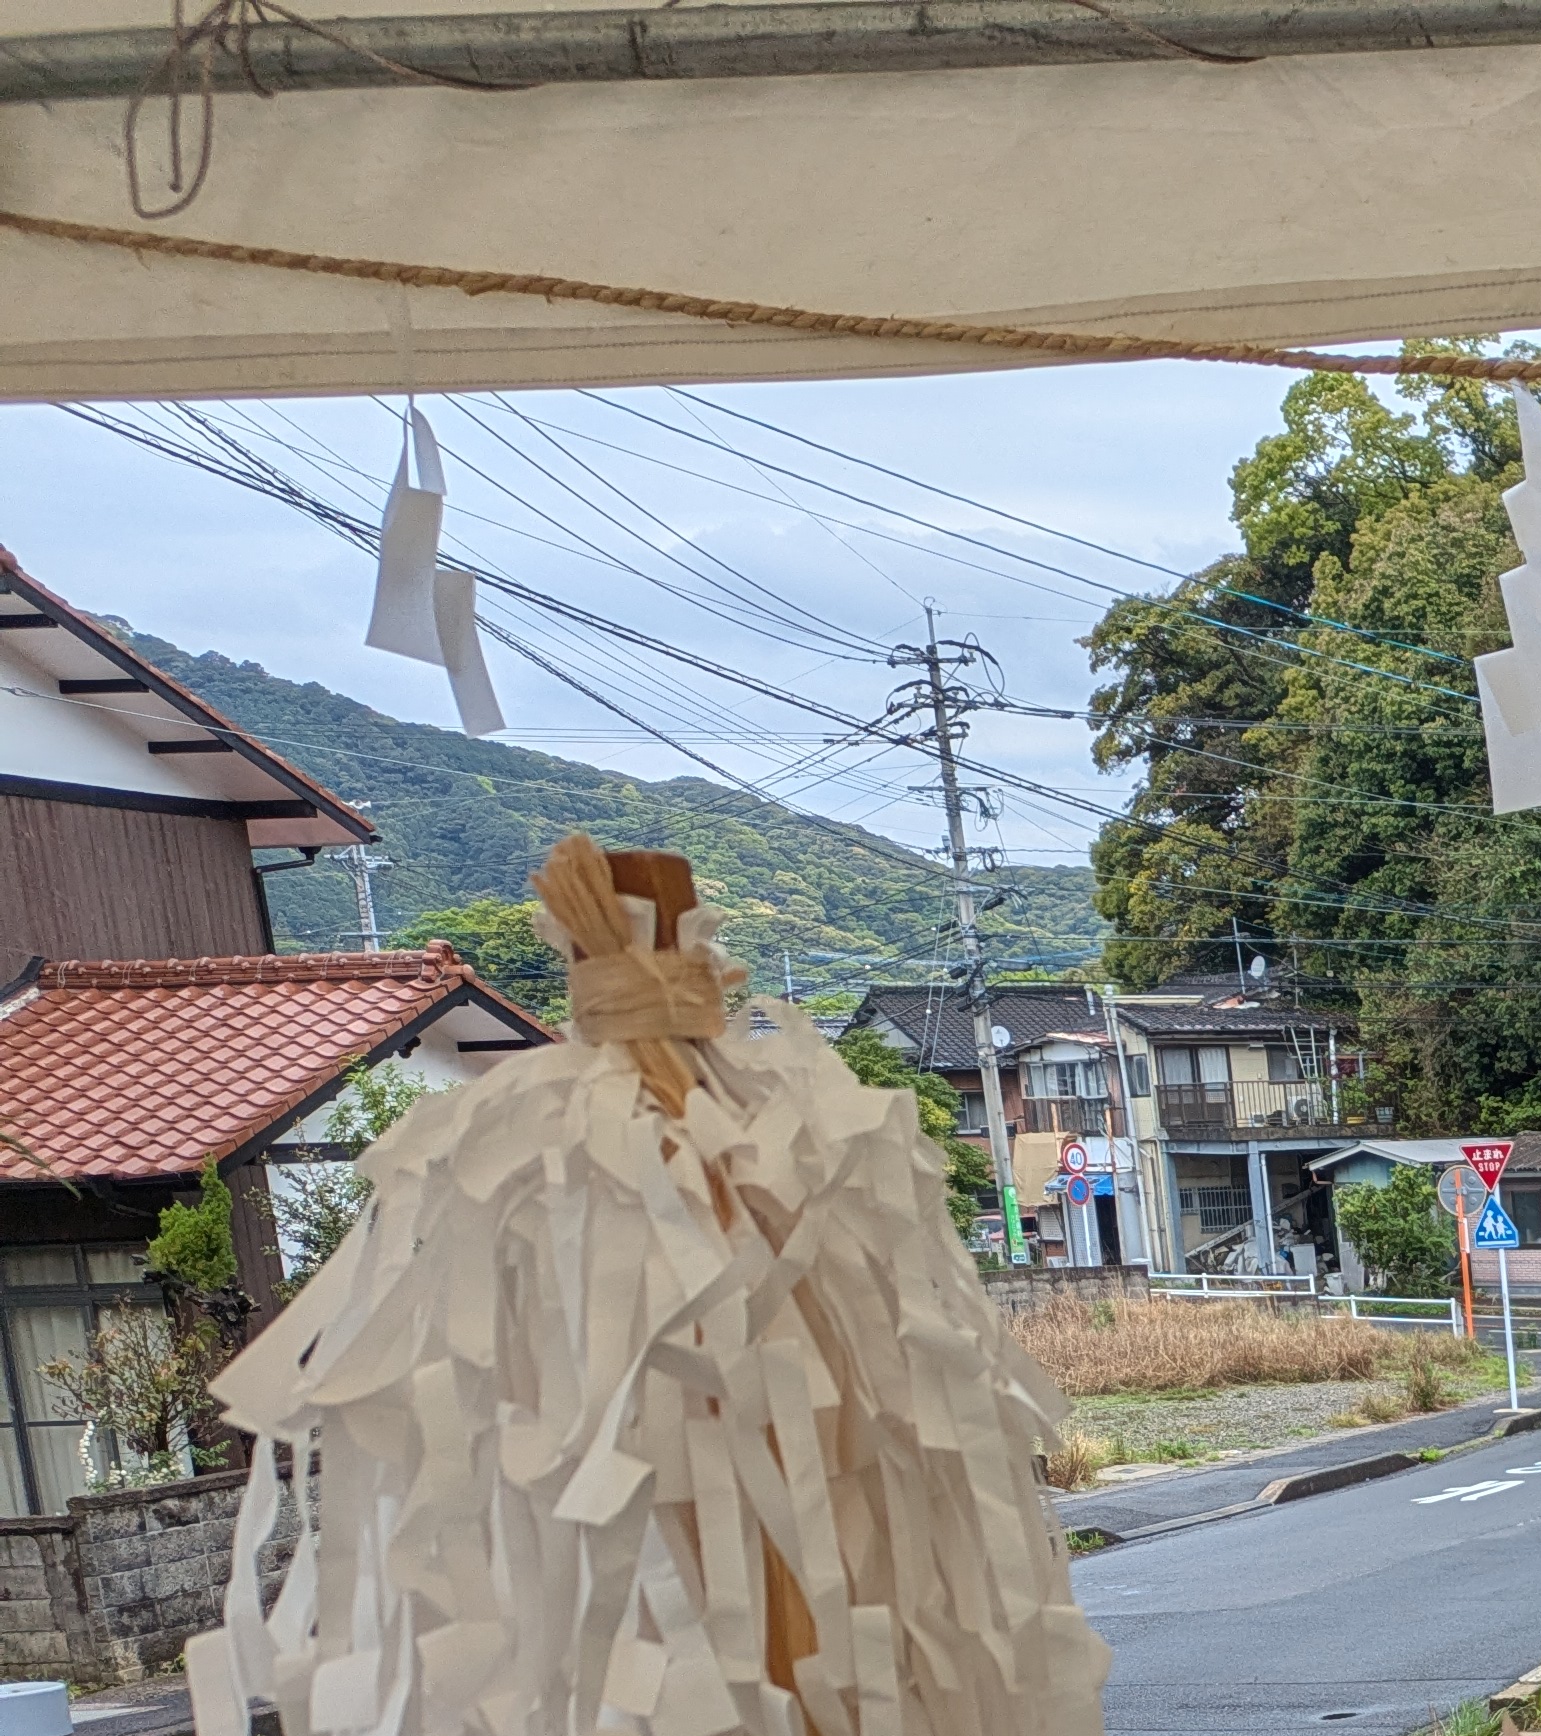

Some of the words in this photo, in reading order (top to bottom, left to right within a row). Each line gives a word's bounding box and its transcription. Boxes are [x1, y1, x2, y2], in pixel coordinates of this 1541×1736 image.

[1070, 1152, 1082, 1166] 40
[1472, 1149, 1504, 1161] 止まれ
[1478, 1162, 1500, 1173] STOP
